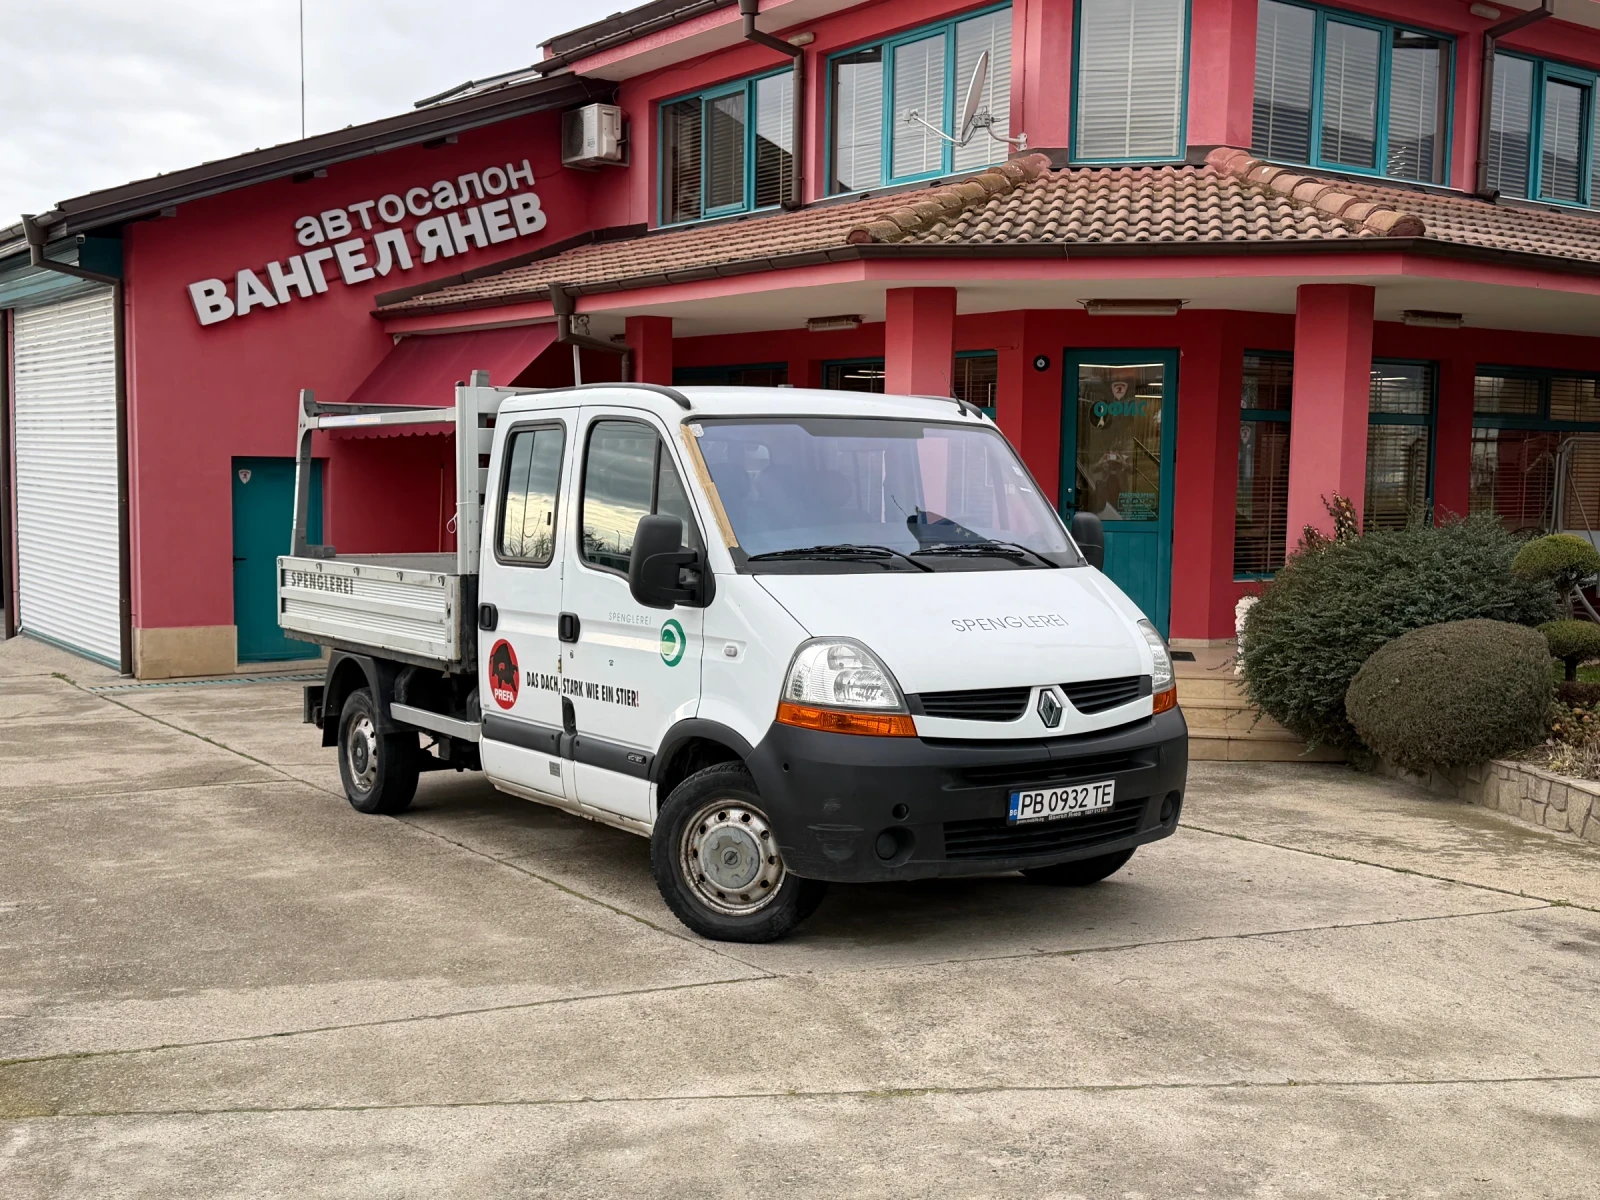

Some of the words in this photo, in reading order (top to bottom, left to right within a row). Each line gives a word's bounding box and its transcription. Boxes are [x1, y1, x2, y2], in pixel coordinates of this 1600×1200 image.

[295, 159, 535, 246] автосалон
[188, 228, 414, 325] ВАНГЕЛ
[415, 193, 547, 263] ЯНЕВ
[1094, 401, 1147, 417] ОФИС
[291, 572, 354, 595] SPENGLEREI
[608, 612, 652, 625] SPENGLEREI
[951, 613, 1069, 632] SPENGLEREI
[494, 688, 515, 703] PREFA
[526, 671, 539, 688] DAS
[541, 674, 561, 695] DACH,
[562, 677, 584, 697] STARK
[586, 681, 600, 700] WIE
[602, 684, 614, 703] EIN
[616, 687, 640, 708] STIER!
[1021, 793, 1044, 816] PB
[1048, 787, 1089, 812] 0932
[1093, 783, 1112, 807] TE
